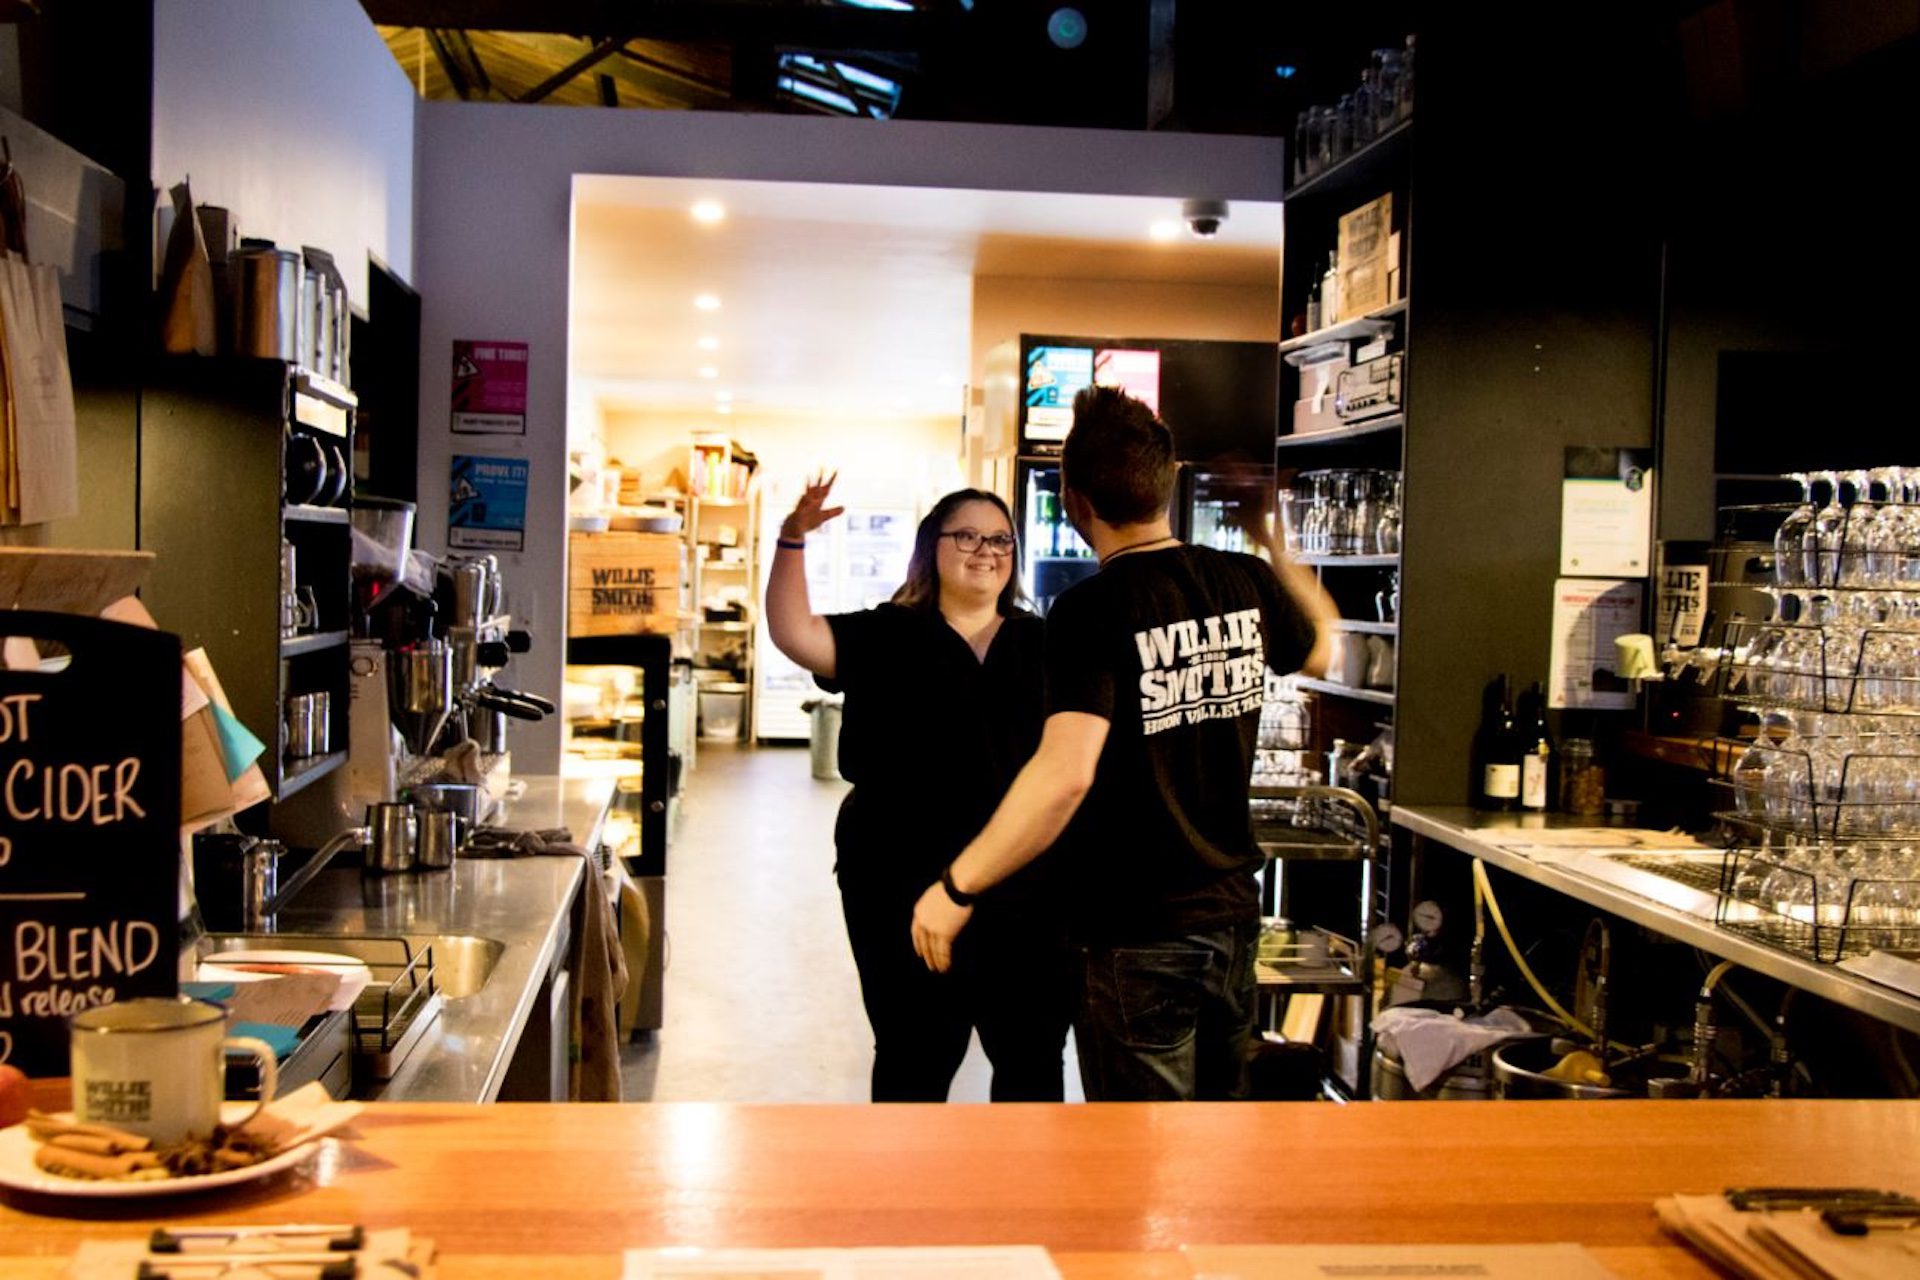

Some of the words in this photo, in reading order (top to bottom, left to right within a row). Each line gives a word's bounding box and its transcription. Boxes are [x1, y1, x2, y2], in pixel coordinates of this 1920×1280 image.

[592, 568, 655, 586] WILLIE
[1134, 608, 1263, 671] WILLIE
[5, 757, 146, 825] CIDER
[15, 921, 160, 982] BLEND
[21, 983, 116, 1017] release
